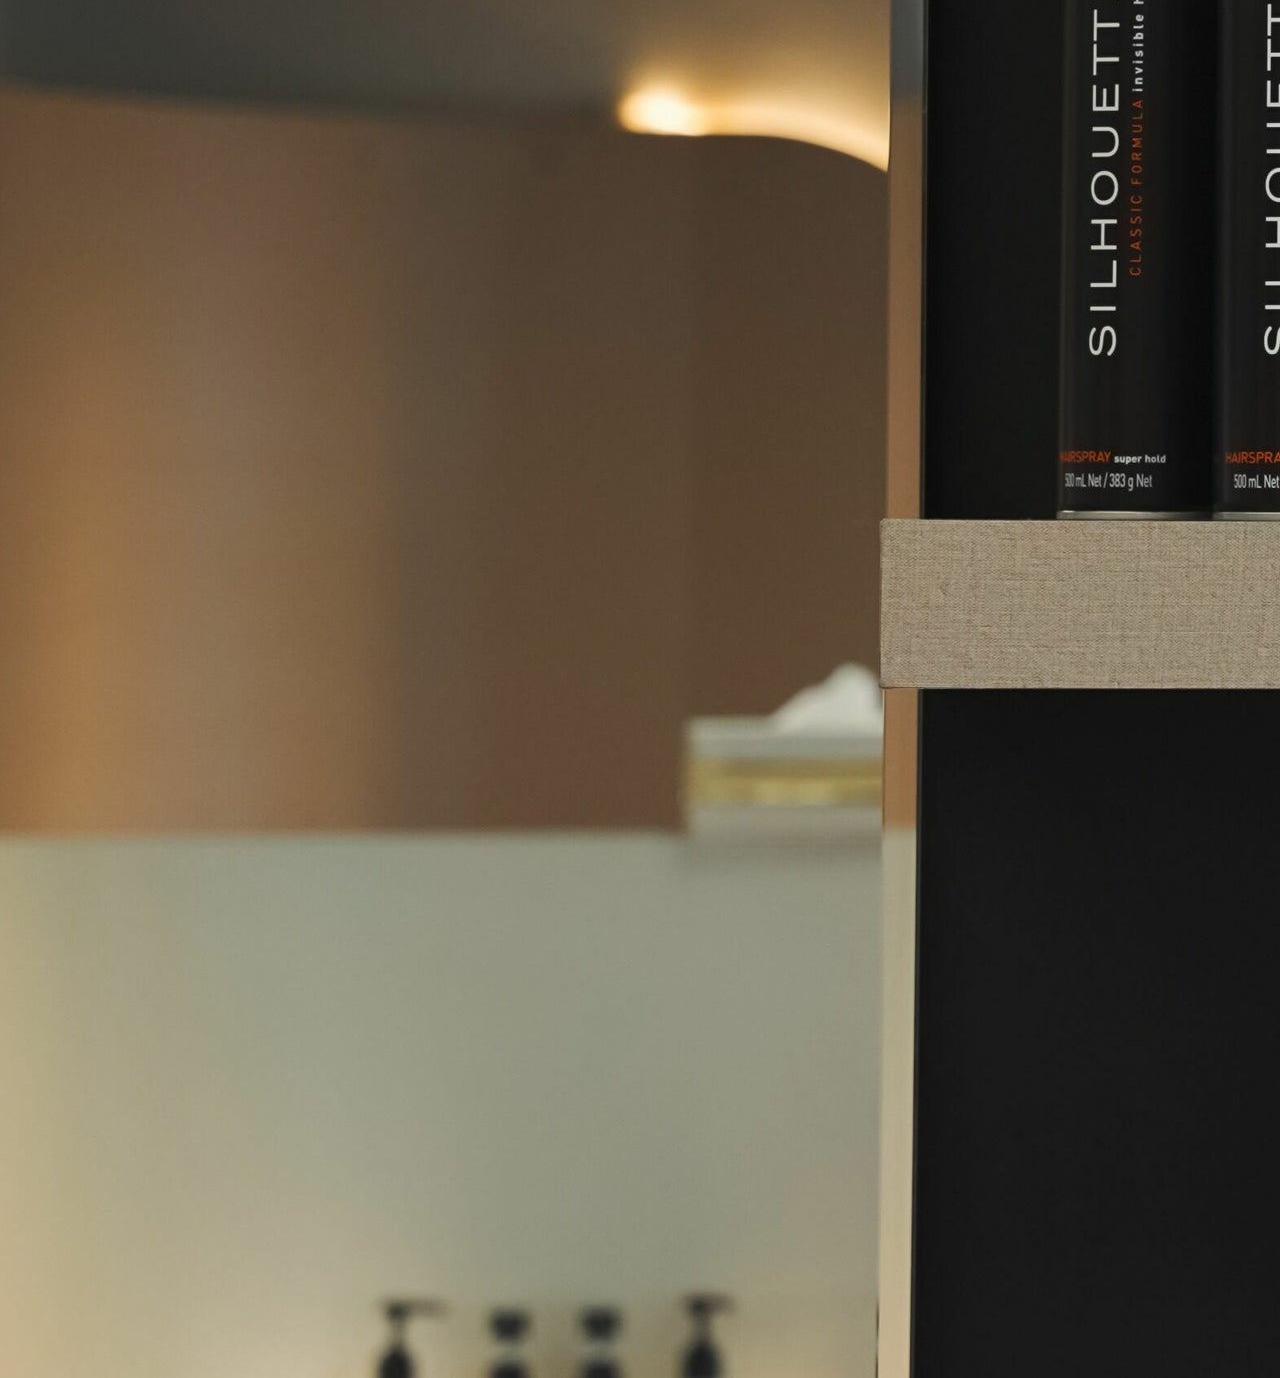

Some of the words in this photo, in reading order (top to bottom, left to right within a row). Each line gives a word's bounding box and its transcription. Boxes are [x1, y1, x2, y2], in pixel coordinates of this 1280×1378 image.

[1131, 14, 1144, 92] invisible
[1130, 100, 1142, 185] FORMULA
[1129, 196, 1142, 276] CLASSIC
[1114, 456, 1142, 465] super
[1145, 455, 1166, 463] hold
[1234, 474, 1247, 488] 500
[1248, 475, 1262, 488] mL
[1264, 474, 1280, 488] Net
